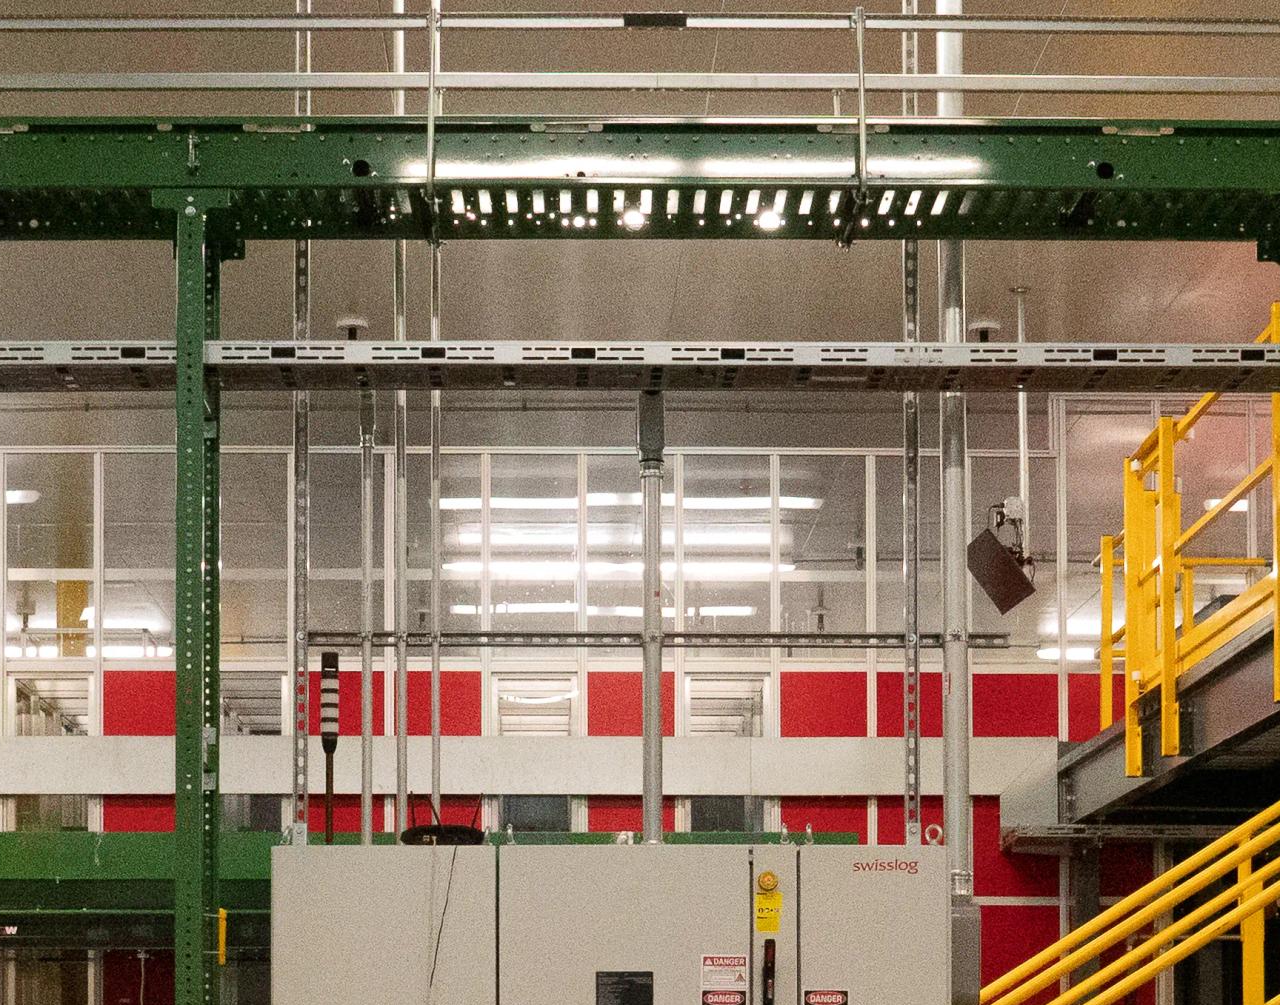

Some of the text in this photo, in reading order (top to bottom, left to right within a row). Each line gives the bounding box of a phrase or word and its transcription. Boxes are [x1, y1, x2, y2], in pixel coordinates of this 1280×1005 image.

[853, 858, 919, 875] swisslog
[713, 957, 745, 966] DANGER
[707, 994, 741, 1003] DANGER
[810, 994, 843, 1003] DANGER
